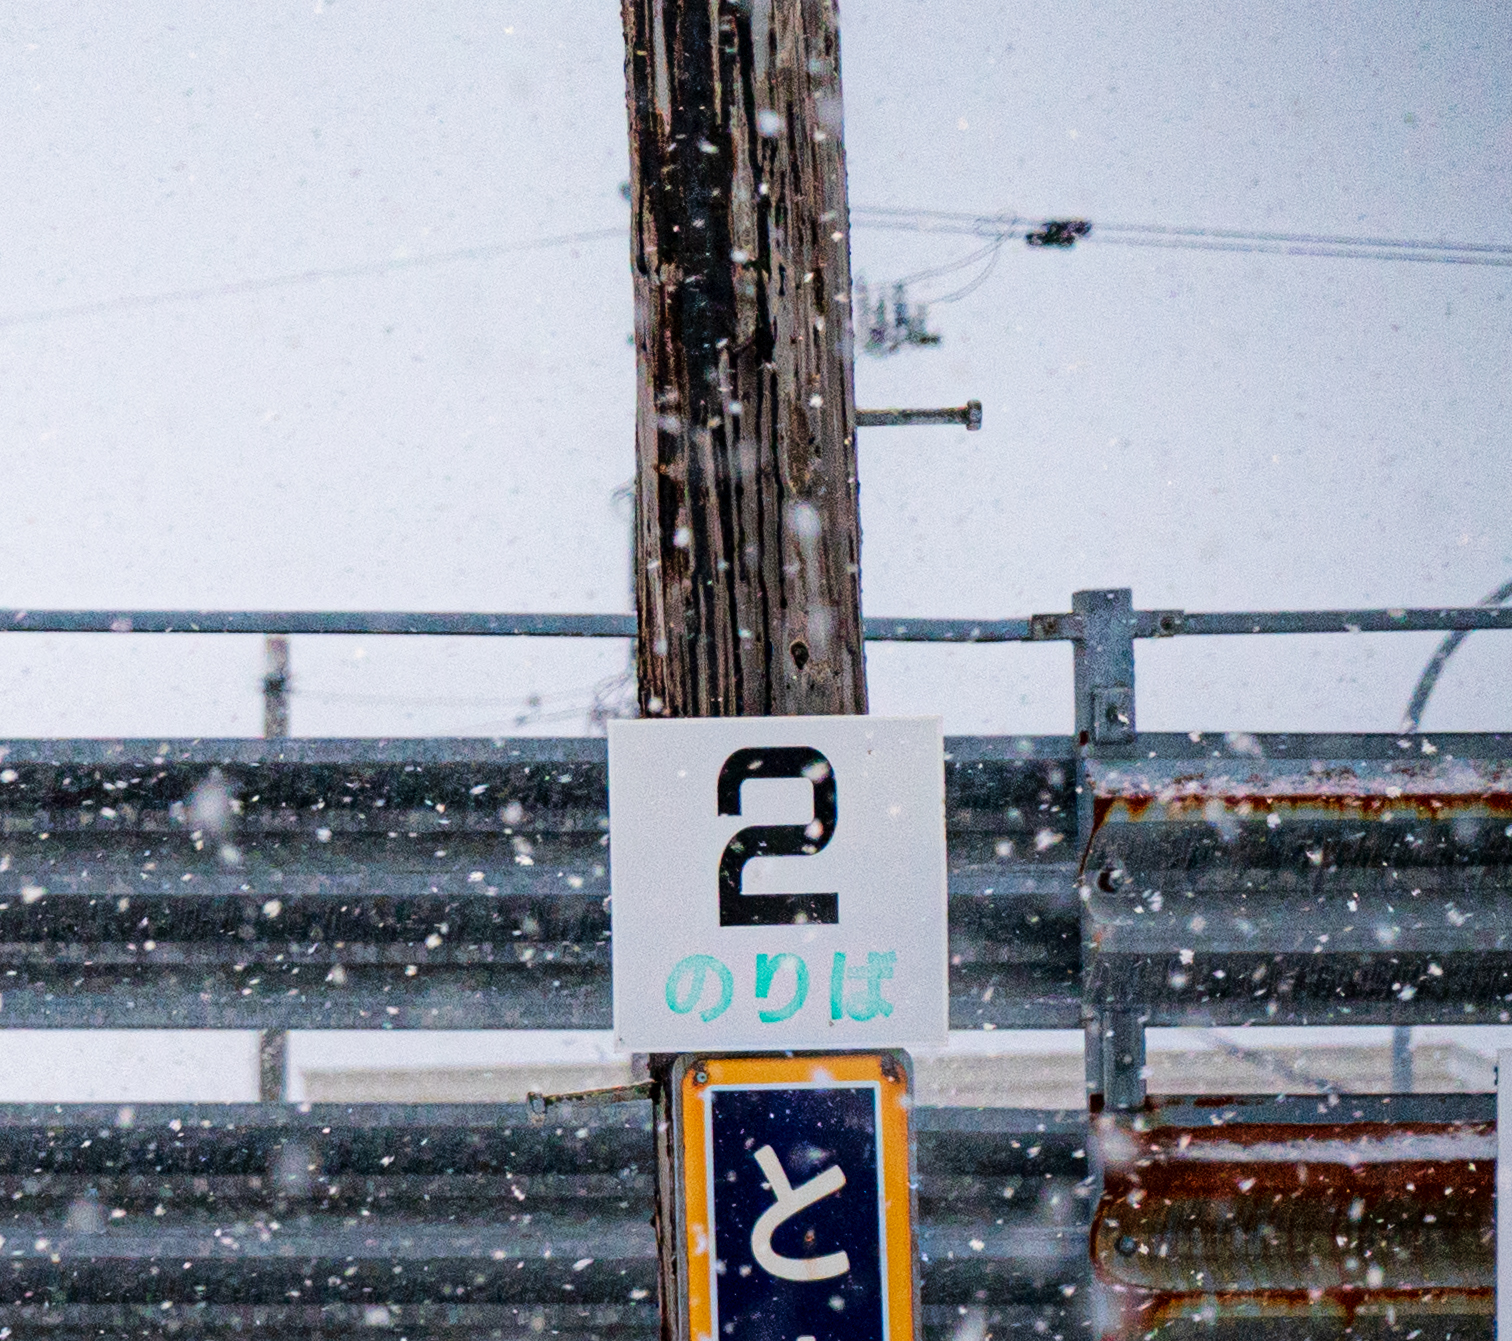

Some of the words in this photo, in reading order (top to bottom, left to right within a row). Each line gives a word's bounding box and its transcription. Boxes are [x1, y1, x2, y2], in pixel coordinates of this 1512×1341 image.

[717, 746, 839, 927] 2
[665, 951, 897, 1024] のりば
